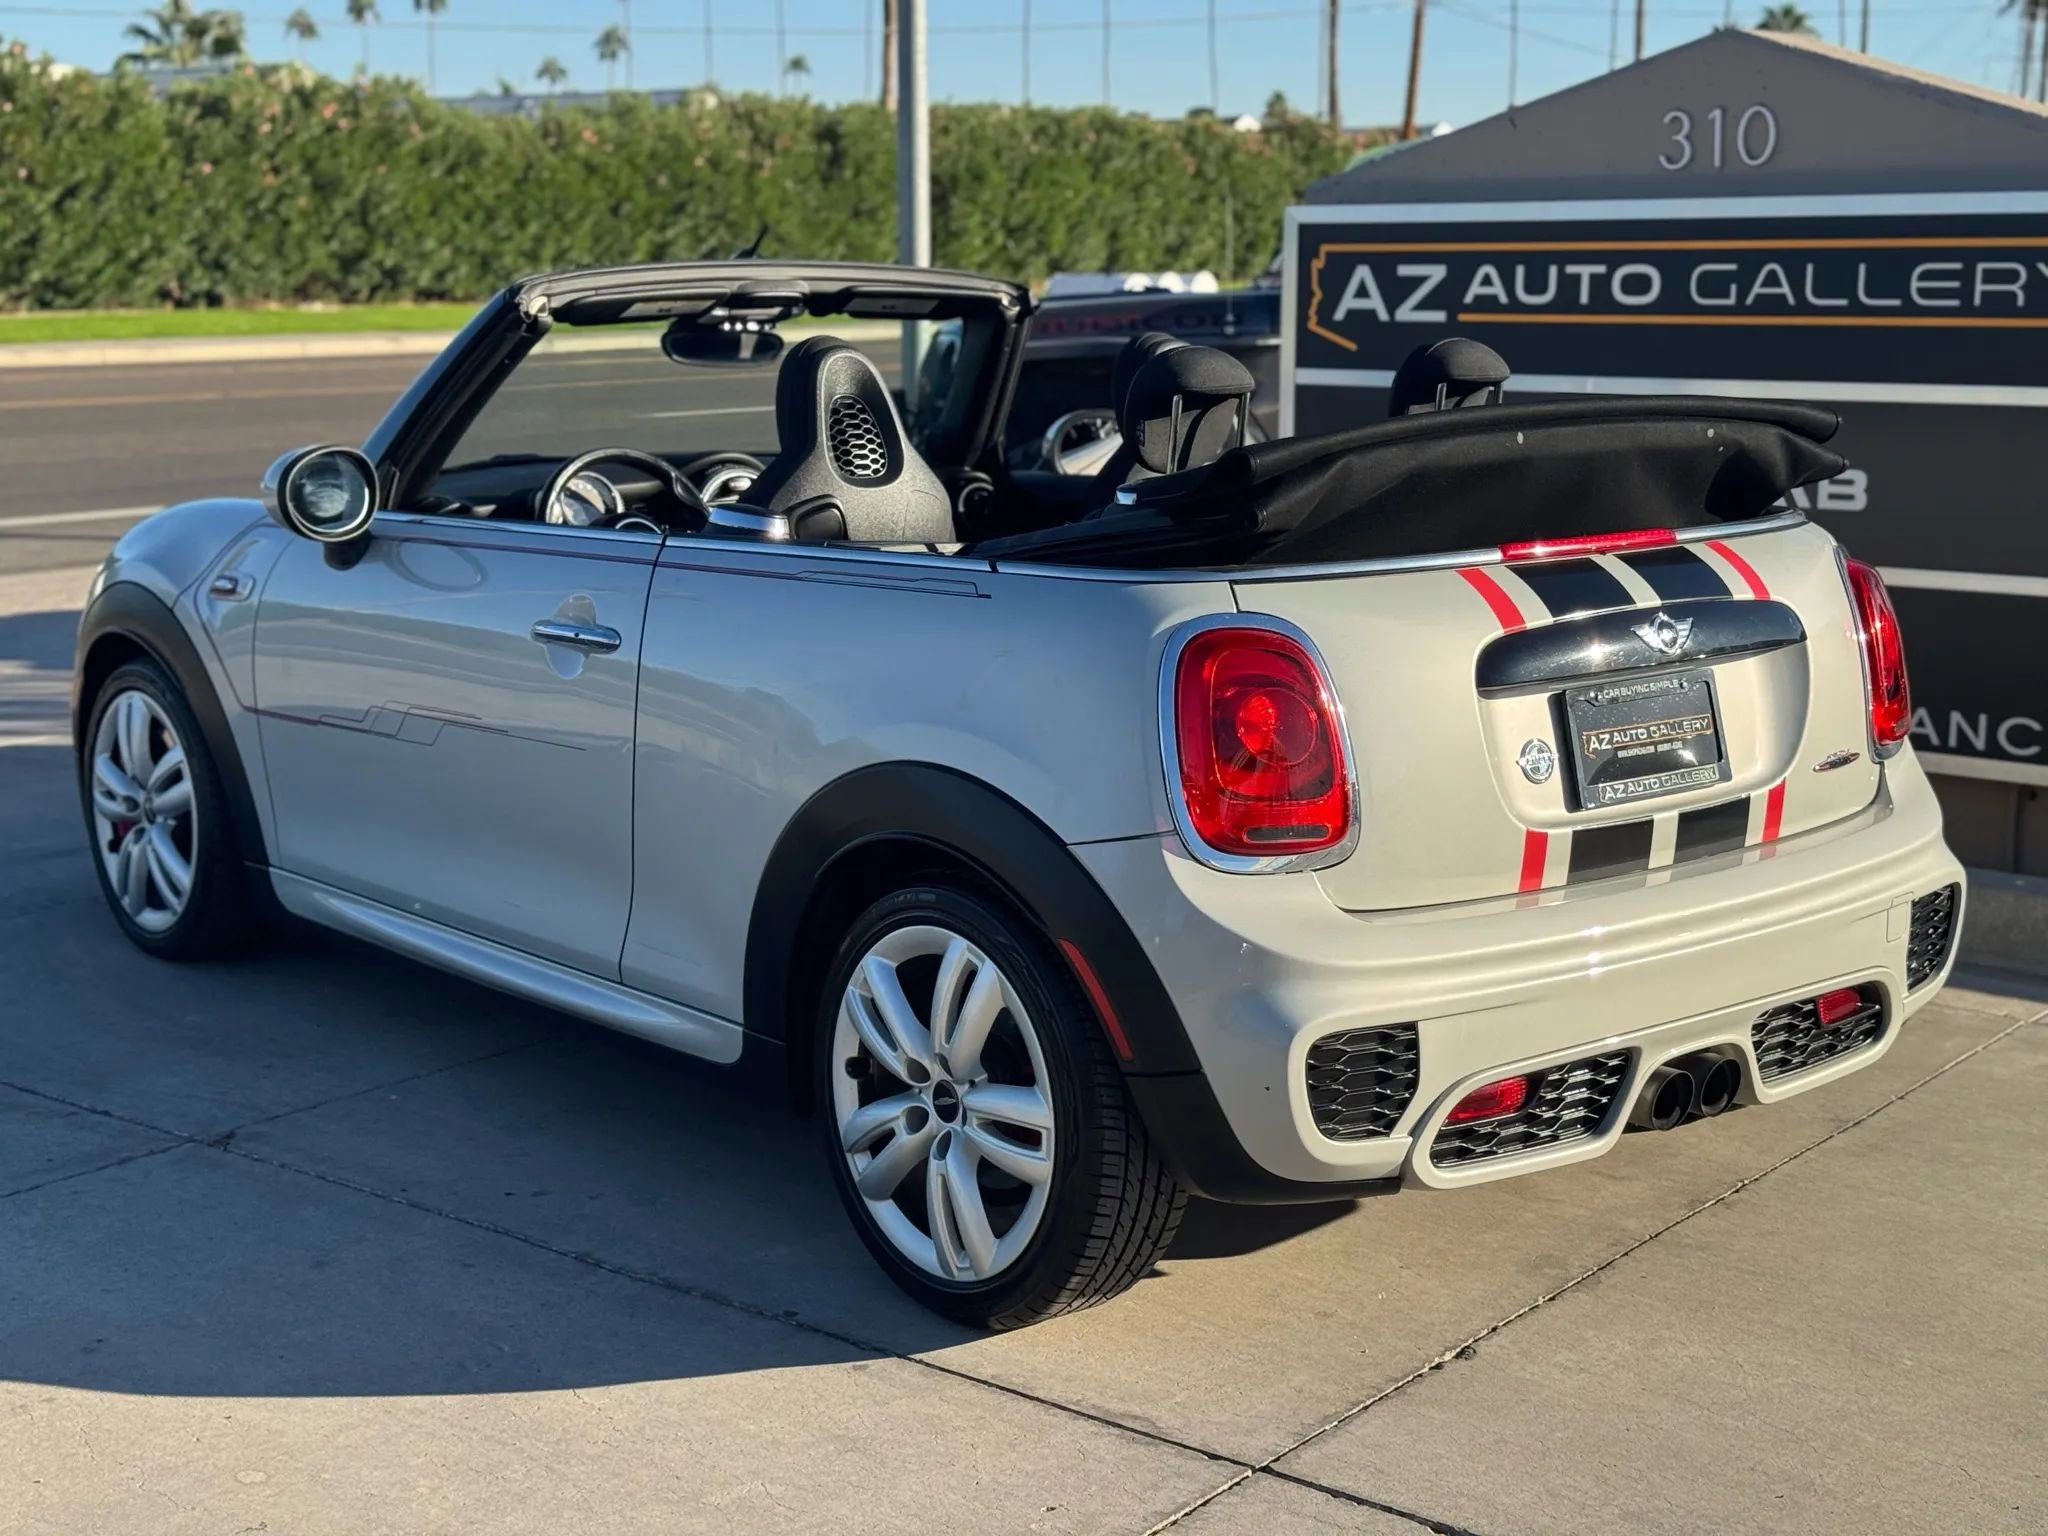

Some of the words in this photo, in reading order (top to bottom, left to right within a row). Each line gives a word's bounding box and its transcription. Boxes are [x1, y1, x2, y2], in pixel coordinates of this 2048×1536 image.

[1658, 105, 1778, 170] 310
[1332, 264, 1448, 323] AZ
[1463, 264, 1662, 305] AUTO
[1602, 686, 1621, 698] CAR
[1620, 683, 1650, 697] BUYING
[1588, 734, 1612, 753] AZ
[1612, 728, 1647, 743] AUTO
[1649, 718, 1709, 737] GALLERY
[1604, 784, 1628, 800] AZ
[1627, 778, 1660, 793] AUTO
[1661, 768, 1717, 786] GALLERY
